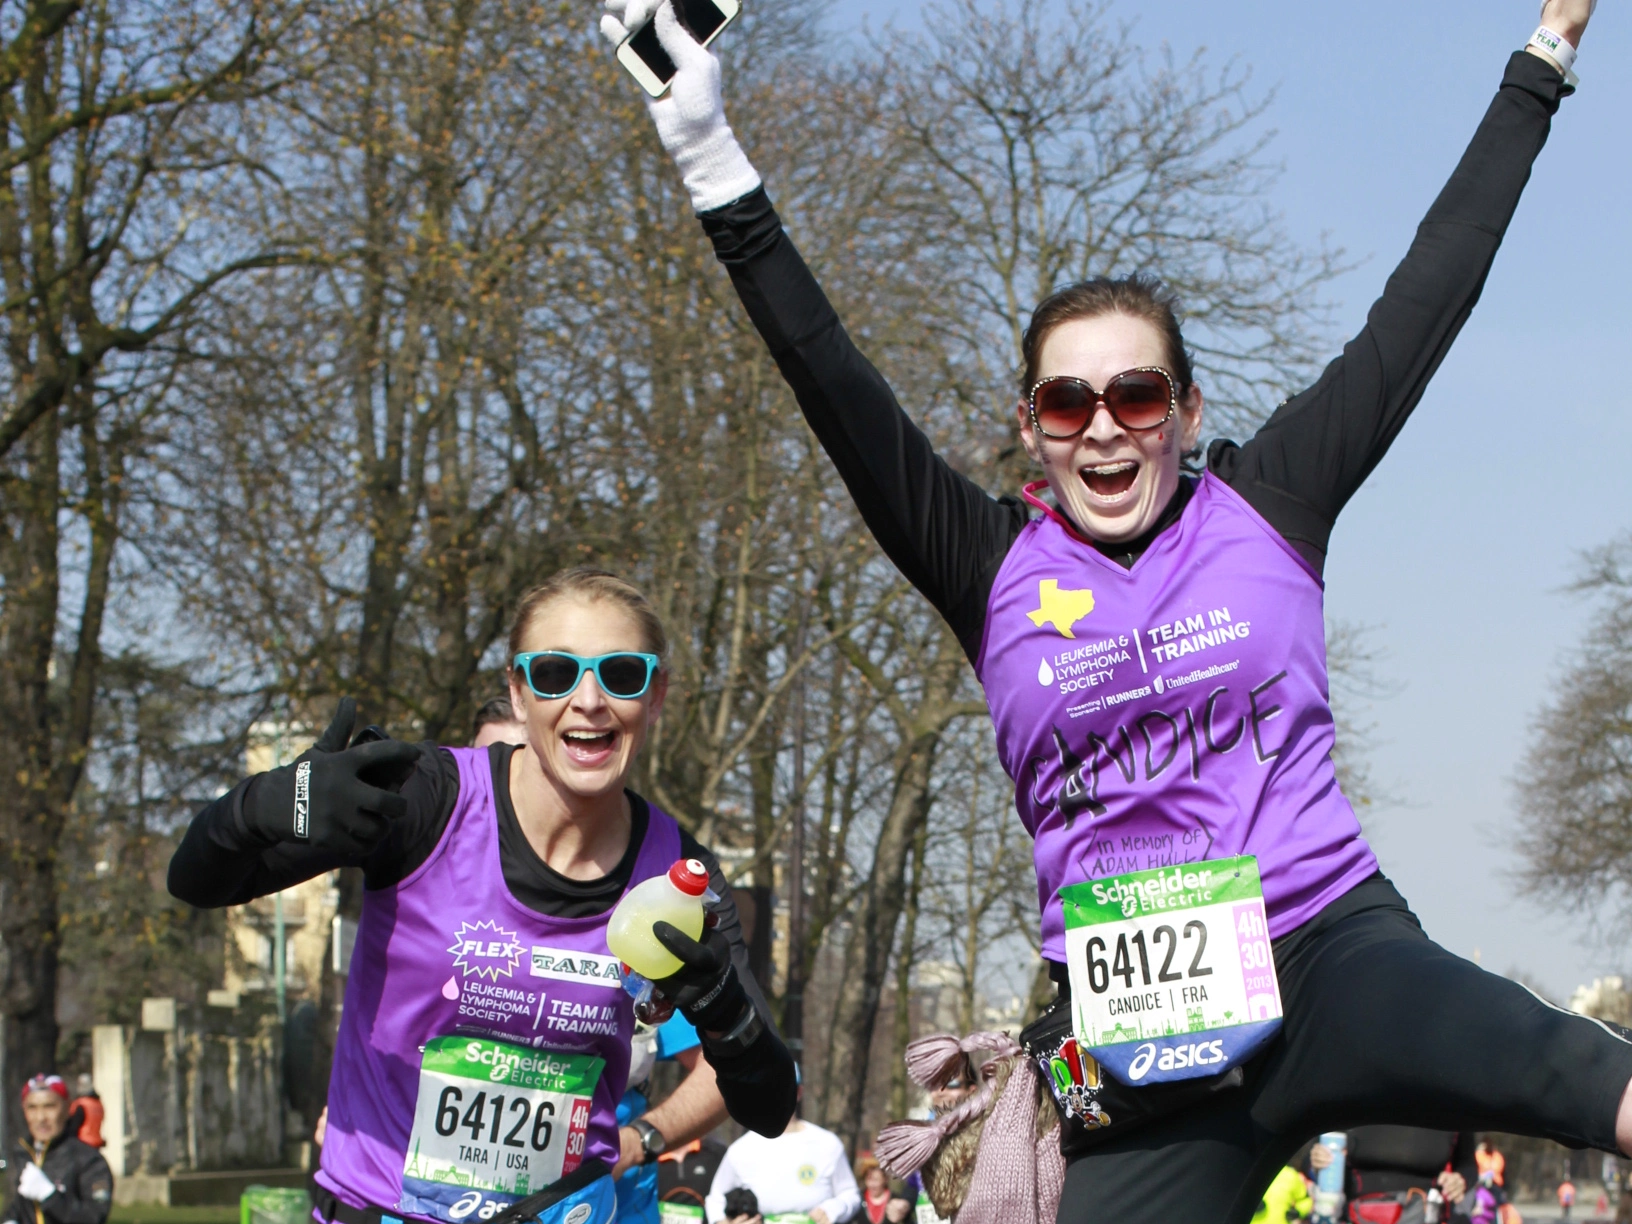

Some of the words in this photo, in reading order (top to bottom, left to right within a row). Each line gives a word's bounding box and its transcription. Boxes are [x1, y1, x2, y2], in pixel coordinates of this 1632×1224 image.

[1536, 33, 1558, 50] TEAM
[1147, 613, 1206, 645] TEAM
[1207, 606, 1232, 627] IN
[1054, 638, 1118, 667] LEUKEMIA
[1118, 634, 1129, 647] &
[1055, 649, 1132, 681] LYMPHOMA
[1165, 659, 1240, 689] UnitedHealthcare
[1059, 668, 1114, 695] SOCIETY
[1091, 855, 1139, 876] ADAM
[1091, 869, 1212, 905] Schneider
[1140, 889, 1213, 912] Electric
[1237, 910, 1263, 938] 4h
[461, 940, 514, 959] FLEX
[1085, 919, 1213, 995] 64122
[1240, 940, 1268, 970] 30
[533, 954, 621, 980] TARA
[463, 980, 525, 1003] LEUKEMIA
[526, 992, 537, 1005] &
[1246, 974, 1273, 991] 2013
[460, 993, 531, 1016] LYMPHOMA
[550, 999, 597, 1020] TEAM
[600, 1006, 616, 1021] IN
[1108, 992, 1163, 1016] CANDICE
[1181, 984, 1209, 1005] FRA
[458, 1004, 512, 1024] SOCIETY
[546, 1016, 619, 1036] TRAINING
[465, 1041, 571, 1077] Schneider
[510, 1069, 567, 1090] Electric
[434, 1085, 556, 1152] 64126
[571, 1106, 590, 1130] 4h
[566, 1132, 586, 1156] 30
[458, 1145, 488, 1165] TARA
[506, 1152, 530, 1171] USA
